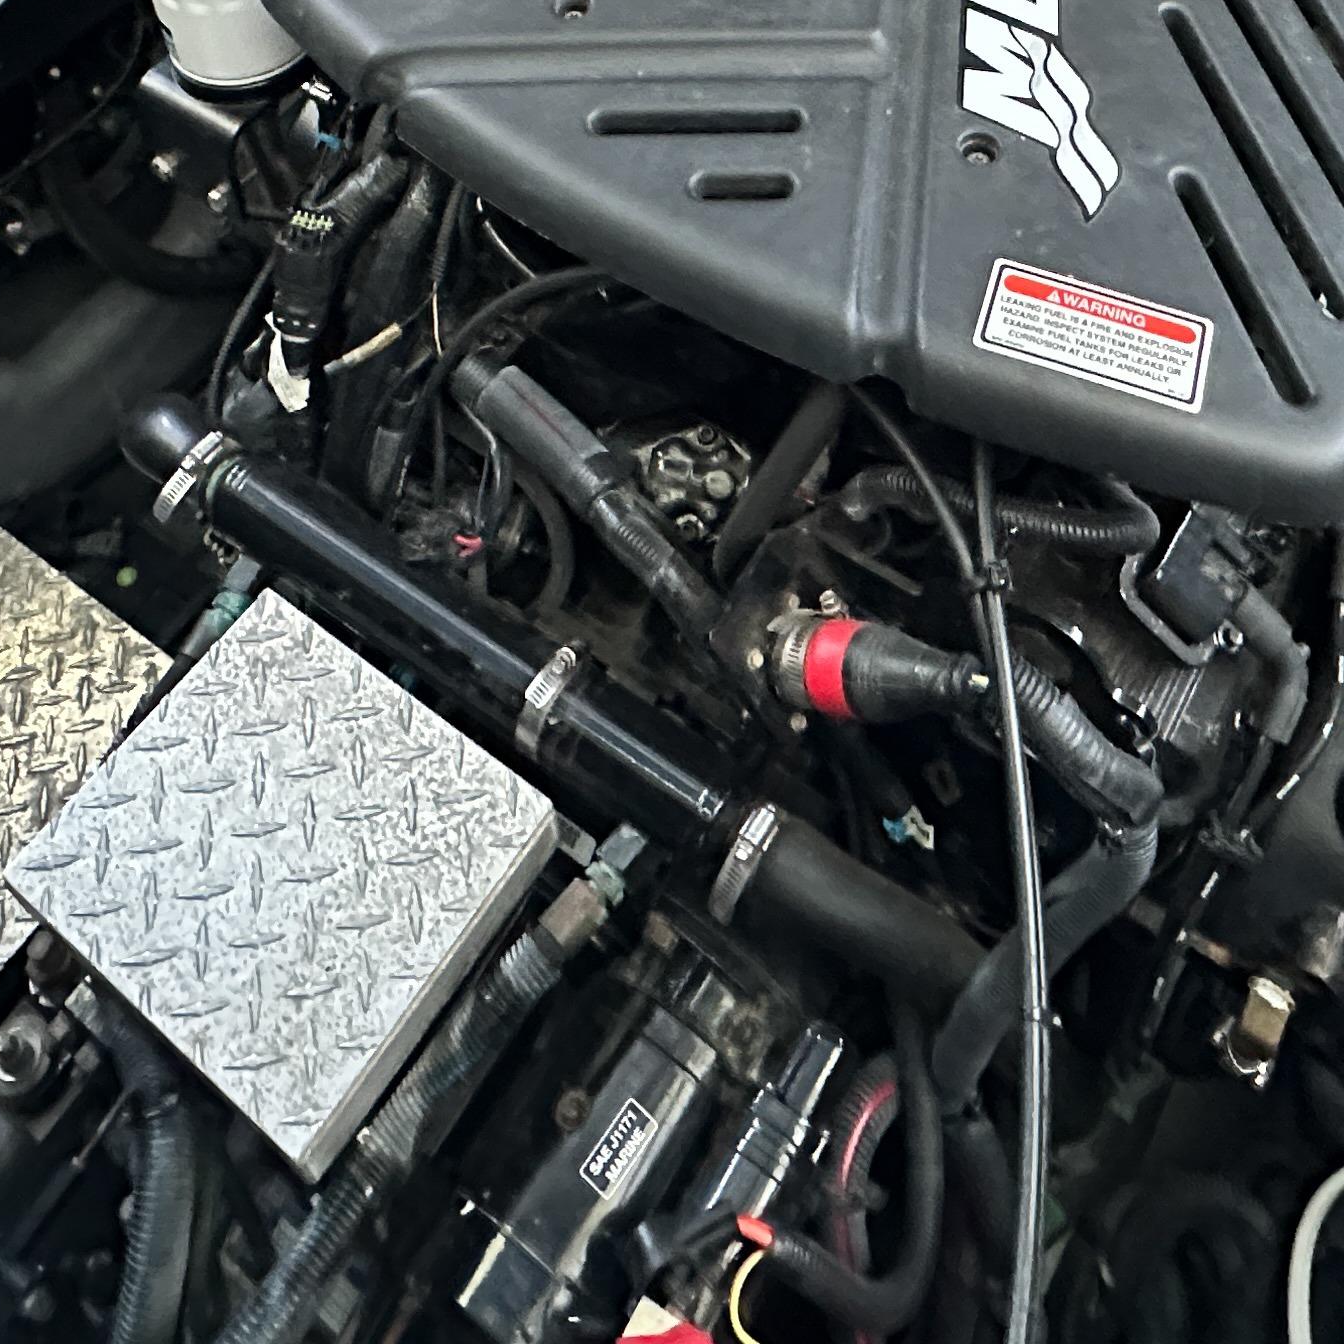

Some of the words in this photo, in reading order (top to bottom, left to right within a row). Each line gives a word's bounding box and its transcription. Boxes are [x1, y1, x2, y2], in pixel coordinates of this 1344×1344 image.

[1043, 306, 1069, 321] FUEL
[1069, 314, 1080, 324] IS
[1080, 317, 1089, 327] A
[1089, 320, 1111, 334] FIRE
[1113, 328, 1135, 341] AND
[1060, 291, 1147, 329] WARNING
[1002, 315, 1045, 335] EXAMINE
[1047, 329, 1073, 343] FUEL
[1073, 337, 1106, 354] TANKS
[1107, 347, 1129, 361] FOR
[1130, 354, 1164, 371] LEAKS
[1007, 327, 1067, 352] CORROSION
[1067, 346, 1081, 356] AT
[1082, 350, 1114, 367] LEAST
[1043, 317, 1085, 336] INSPECT
[1086, 330, 1126, 349] SYSTEM
[588, 1144, 613, 1176] SAE
[608, 1109, 637, 1149] J1171
[604, 1126, 646, 1182] MARINE
